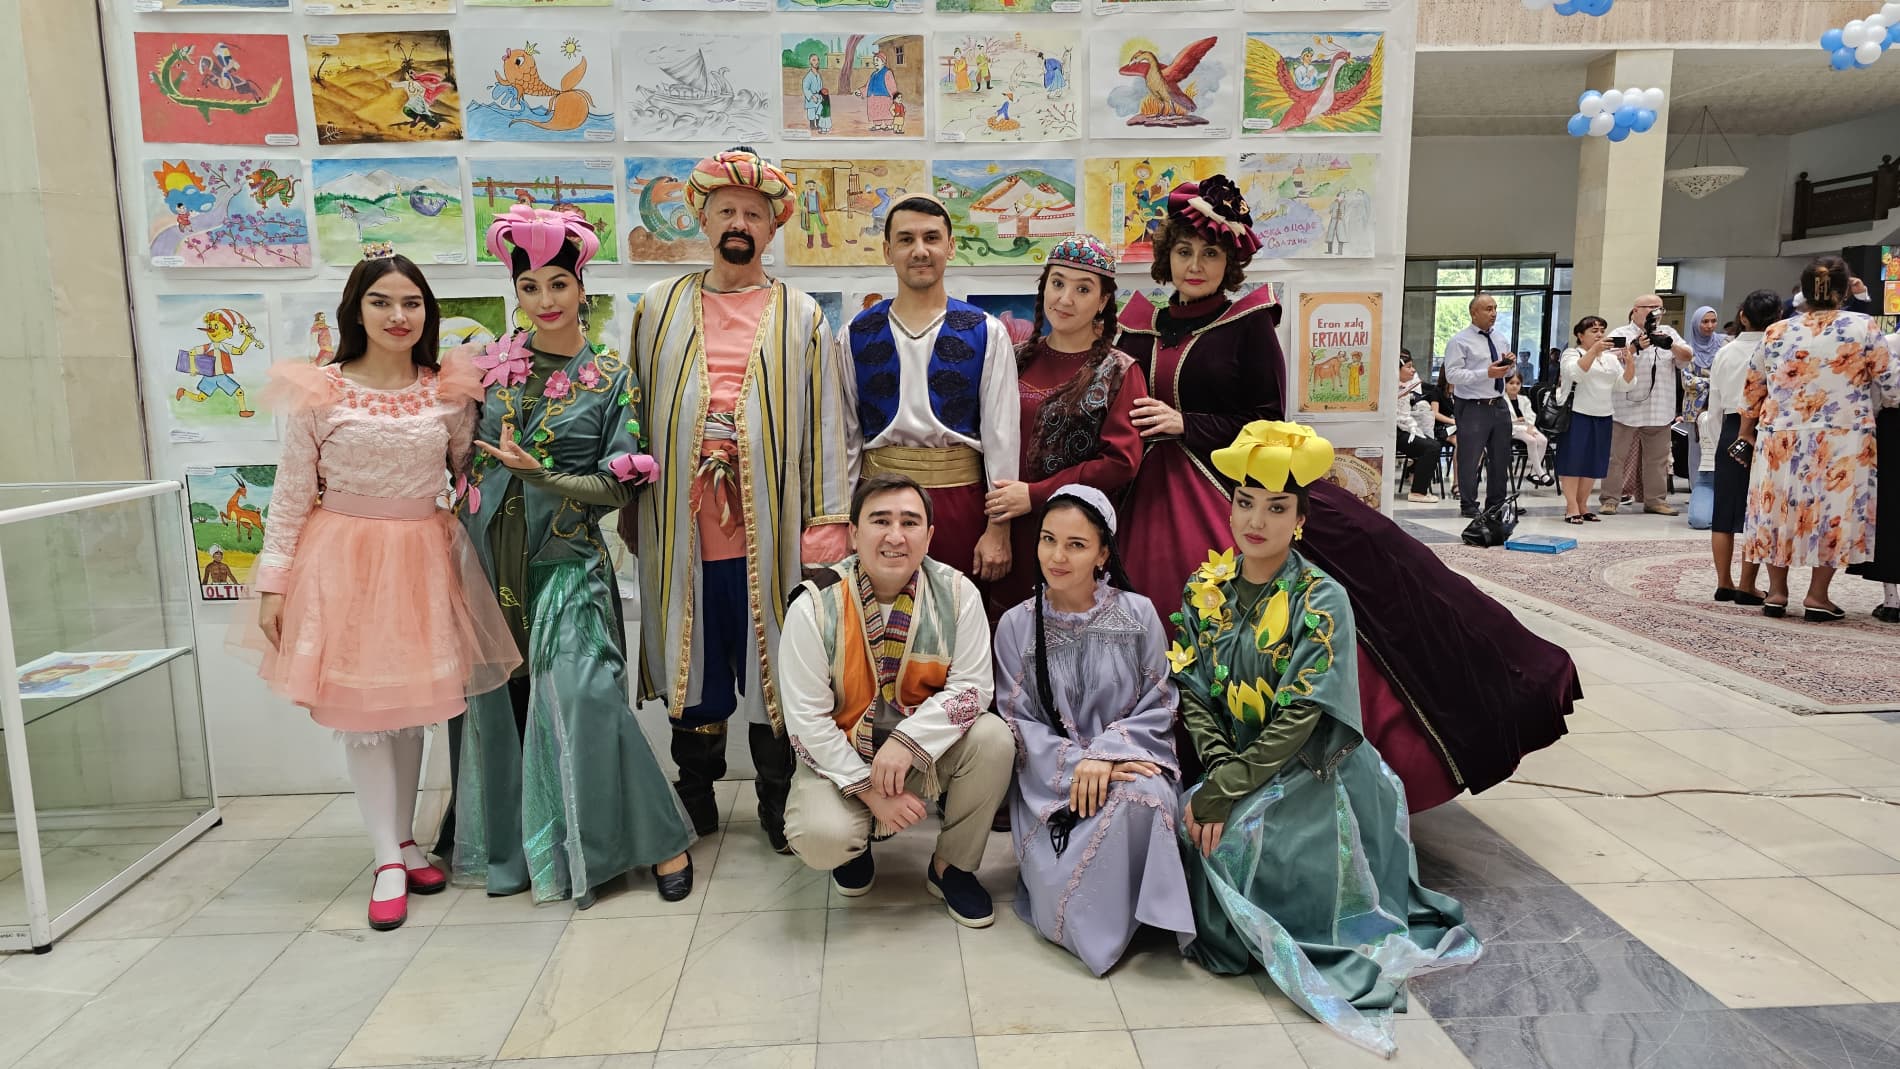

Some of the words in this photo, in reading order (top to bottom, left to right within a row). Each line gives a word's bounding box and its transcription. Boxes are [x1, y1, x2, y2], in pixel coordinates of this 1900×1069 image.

[1317, 318, 1341, 329] Eron
[1344, 317, 1364, 330] xalq
[1312, 331, 1369, 348] ERTAKLARI
